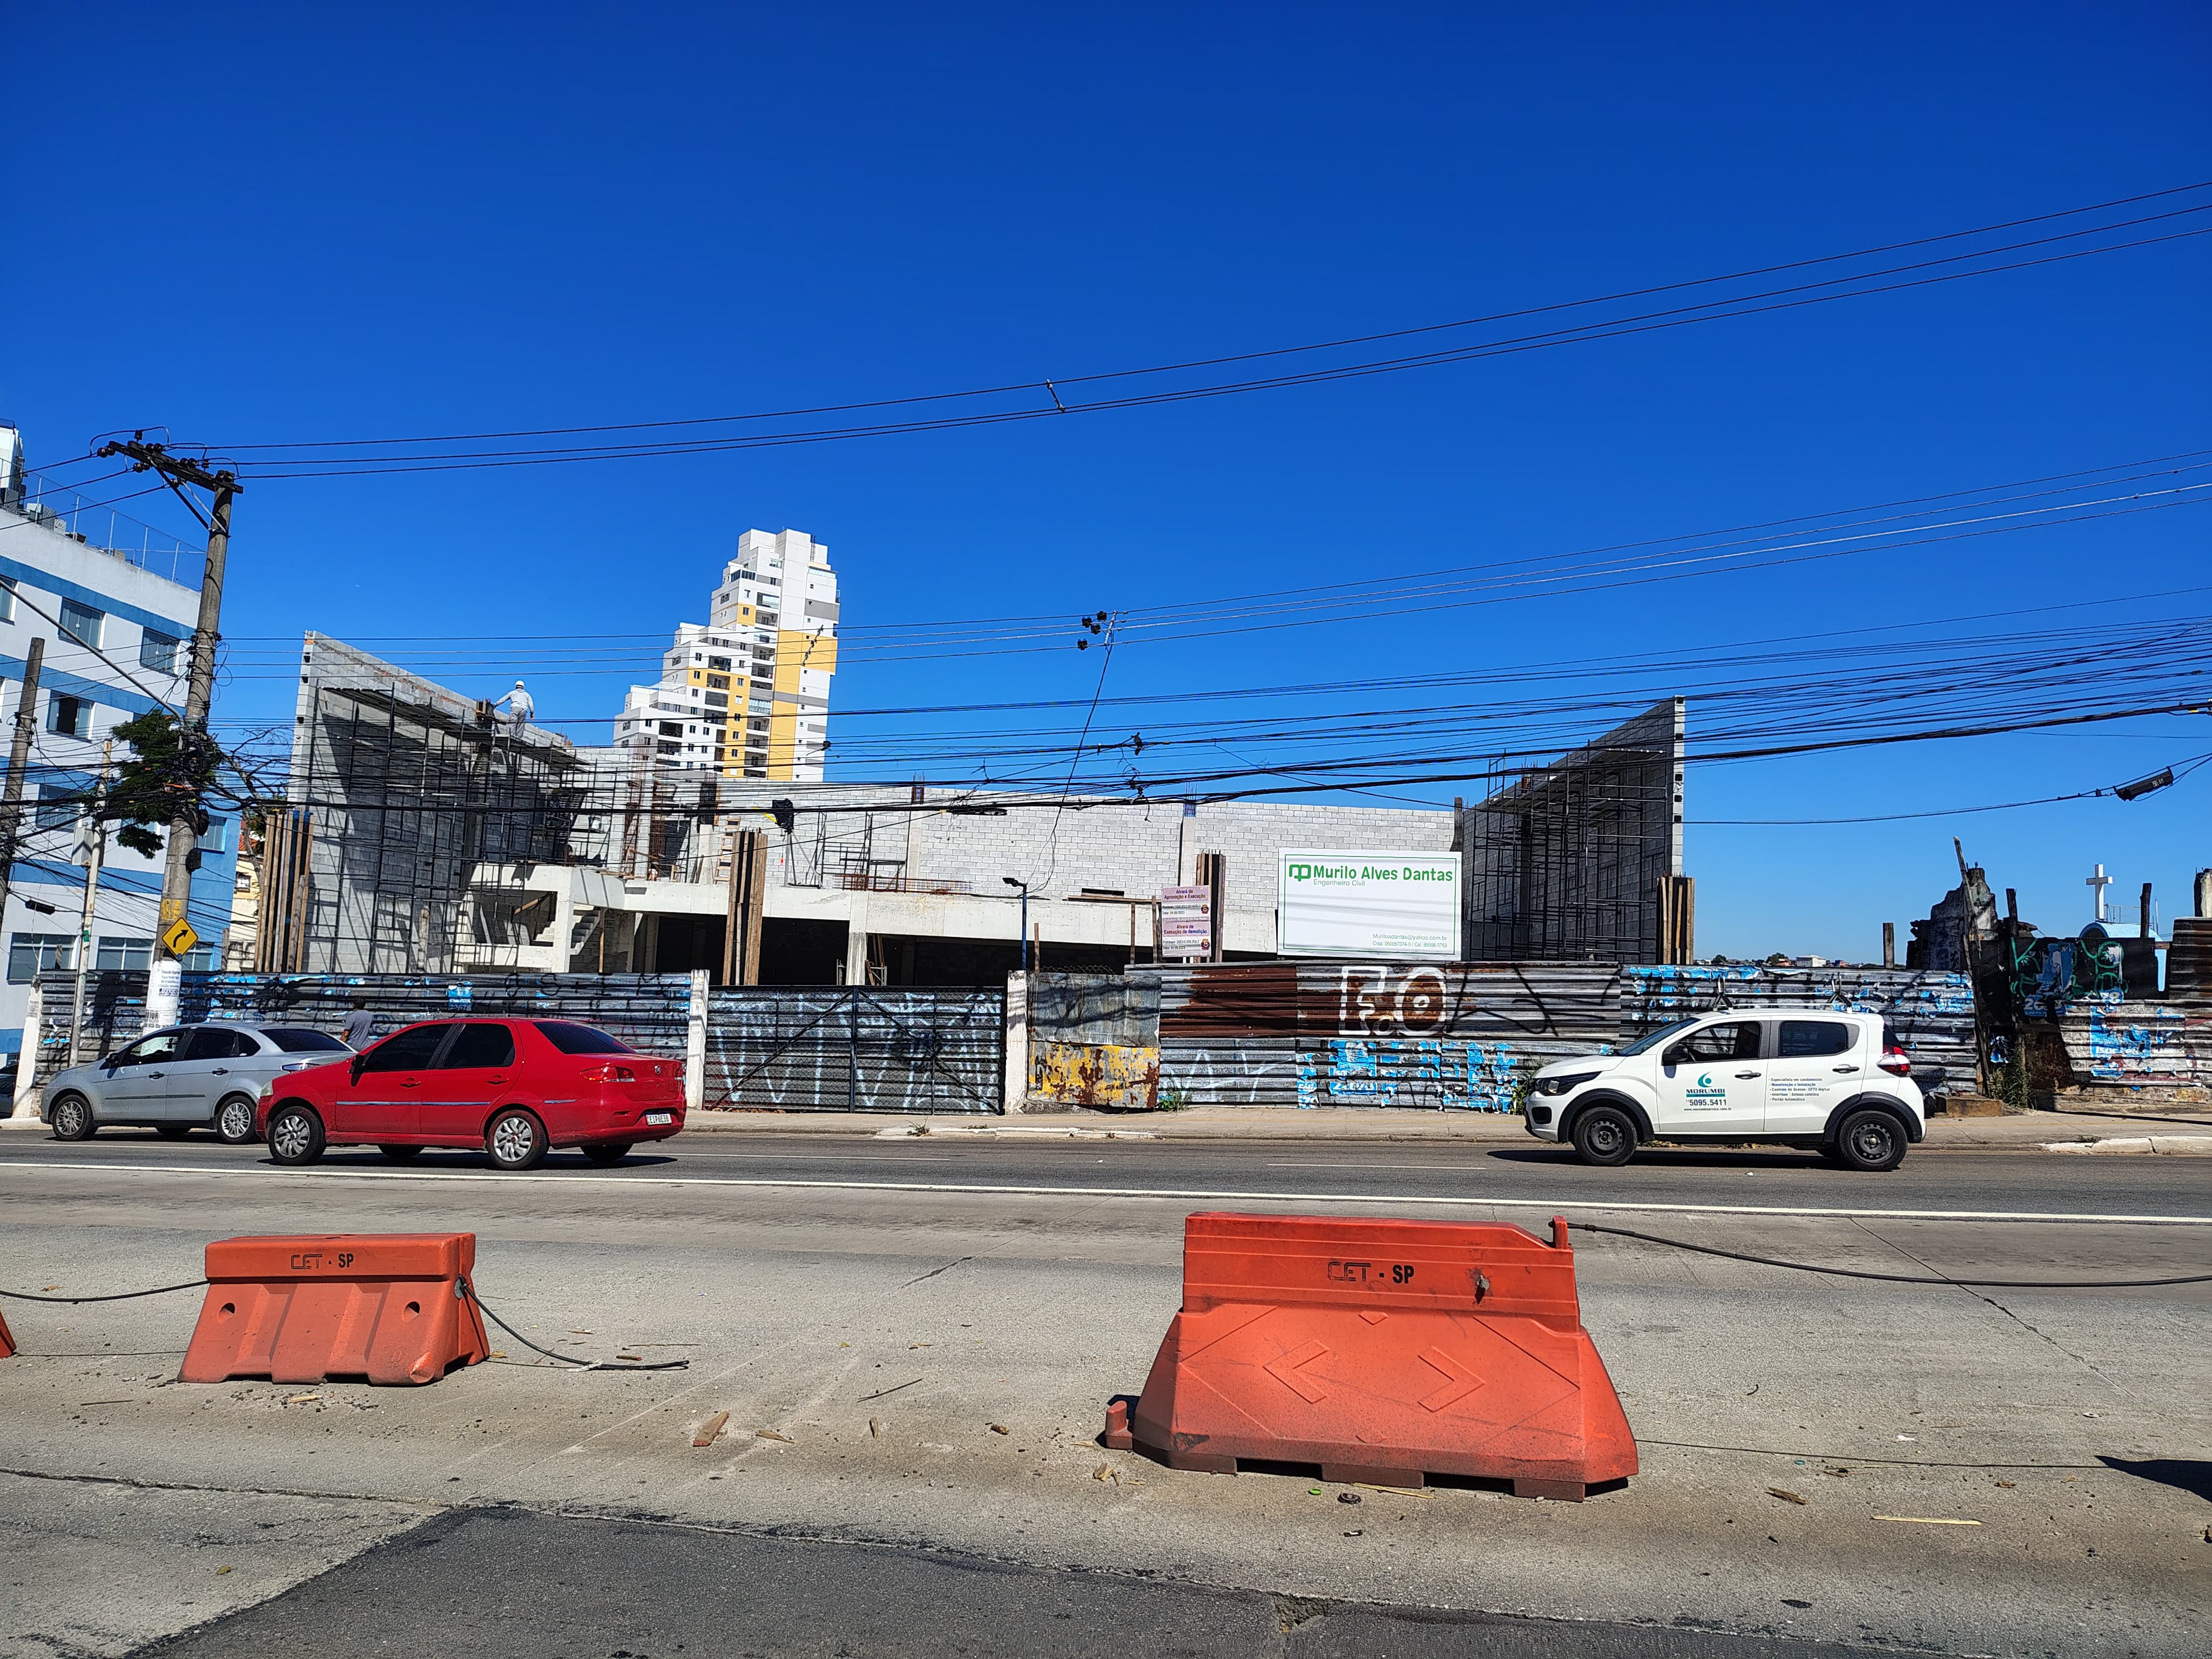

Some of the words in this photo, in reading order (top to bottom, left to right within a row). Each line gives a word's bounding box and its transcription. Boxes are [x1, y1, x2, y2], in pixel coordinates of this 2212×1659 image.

[1313, 865, 1357, 879] Murilo
[1361, 866, 1398, 880] Alves
[1403, 867, 1453, 881] Dantas
[1313, 879, 1350, 887] Engenheiro
[291, 1254, 323, 1270] CET
[338, 1253, 354, 1268] SP
[1327, 1262, 1371, 1282] CET
[1392, 1264, 1414, 1284] SP
